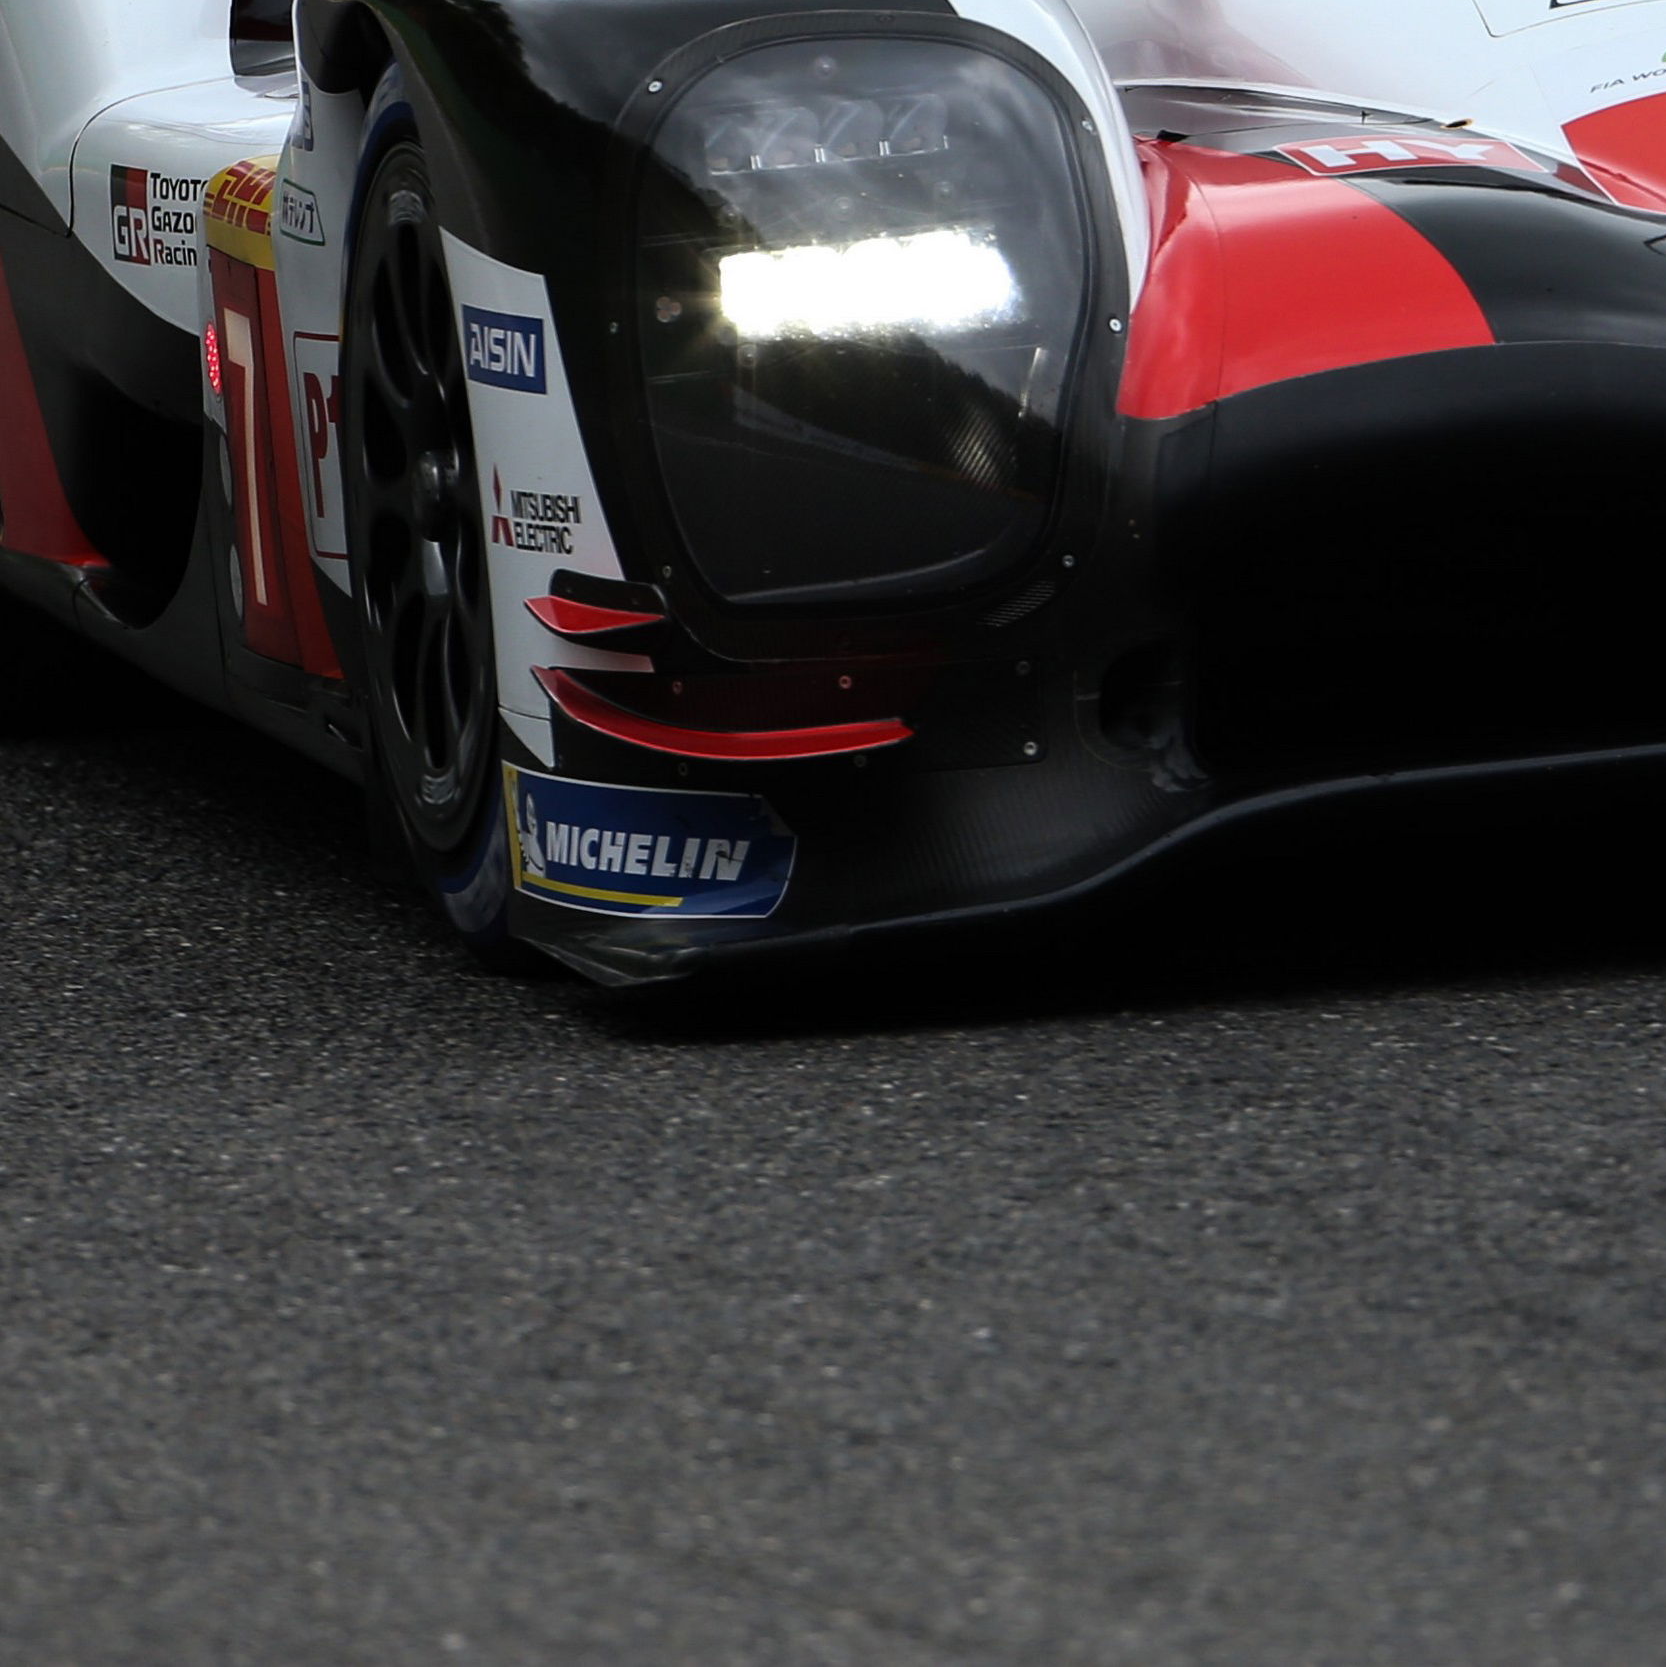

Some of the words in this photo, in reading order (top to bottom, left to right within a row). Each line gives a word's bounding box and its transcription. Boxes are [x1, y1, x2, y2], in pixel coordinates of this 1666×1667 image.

[1589, 79, 1625, 93] FIA
[1303, 139, 1494, 168] HY
[113, 205, 150, 260] GR
[151, 206, 196, 234] GAZO
[469, 322, 535, 377] AISIN
[224, 308, 267, 606] 7
[510, 489, 582, 524] MITSUBISHI
[513, 521, 573, 554] ELECTRIC
[546, 821, 750, 881] MICHELIN
